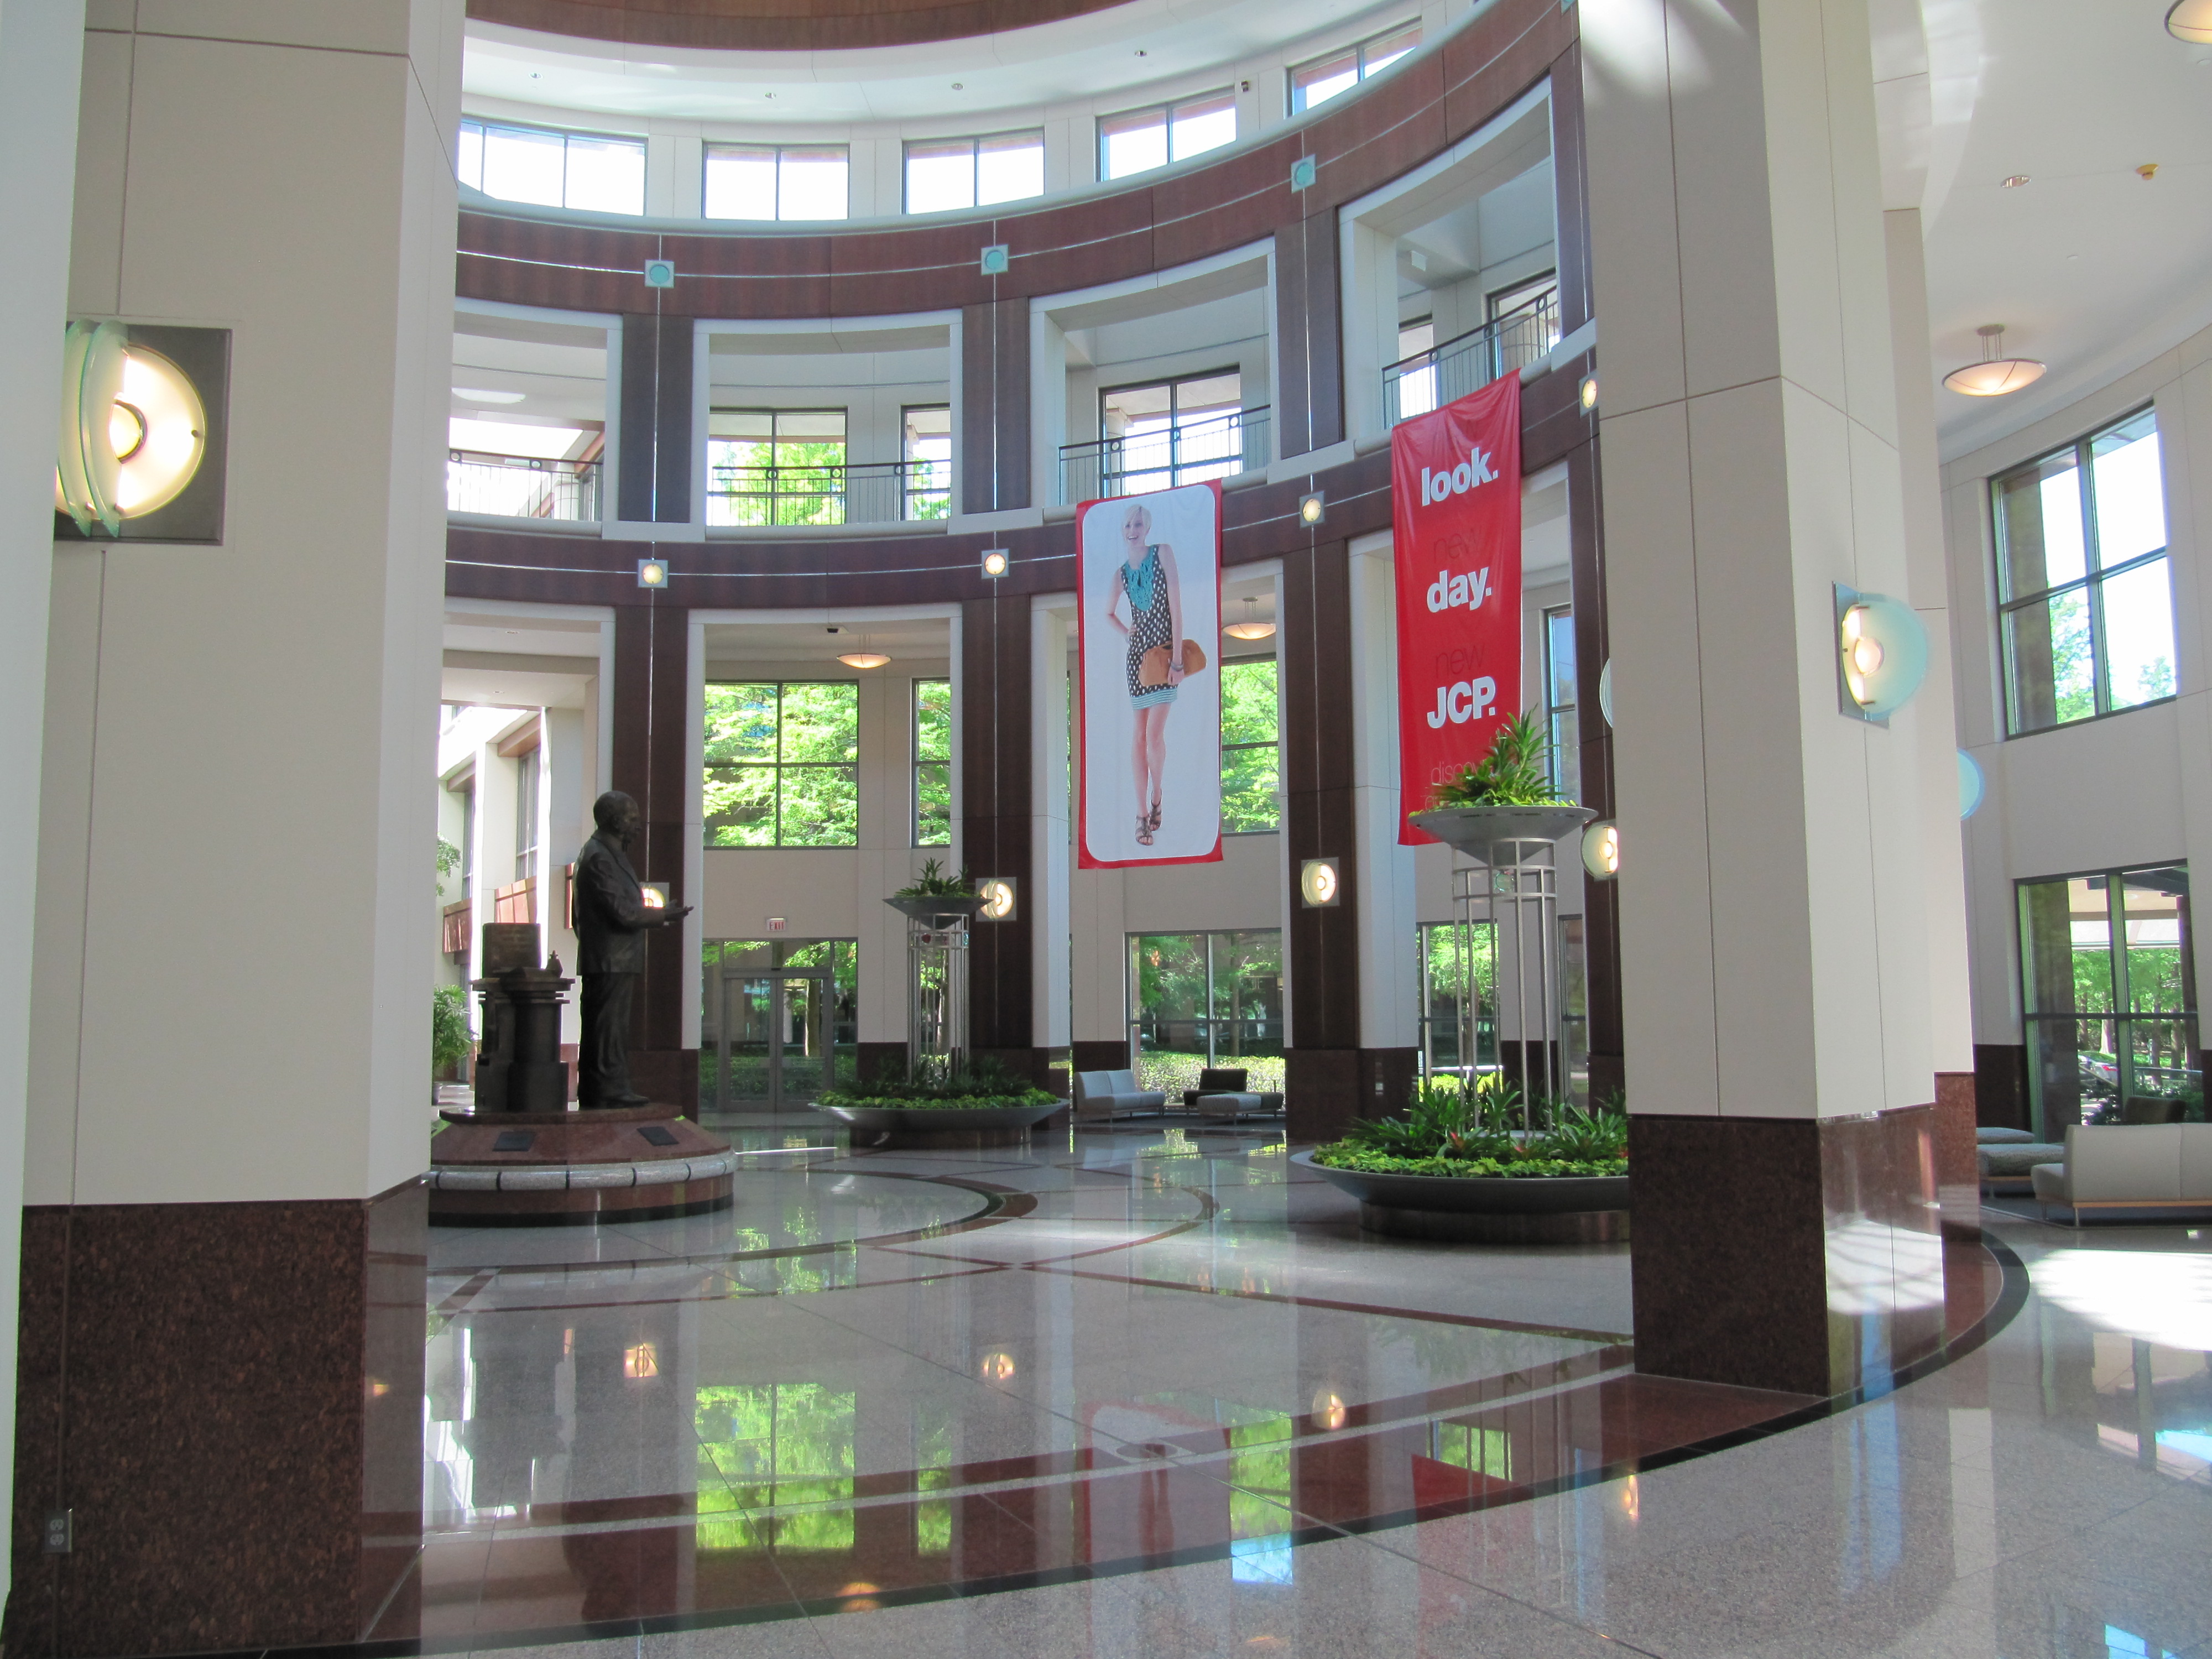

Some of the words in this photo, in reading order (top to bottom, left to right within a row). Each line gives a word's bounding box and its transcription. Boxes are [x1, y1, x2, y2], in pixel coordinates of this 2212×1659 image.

[1422, 447, 1499, 507] look.
[1427, 566, 1492, 613] day.
[1436, 643, 1486, 679] new
[1427, 676, 1496, 729] JCP.
[769, 921, 784, 930] EXIT
